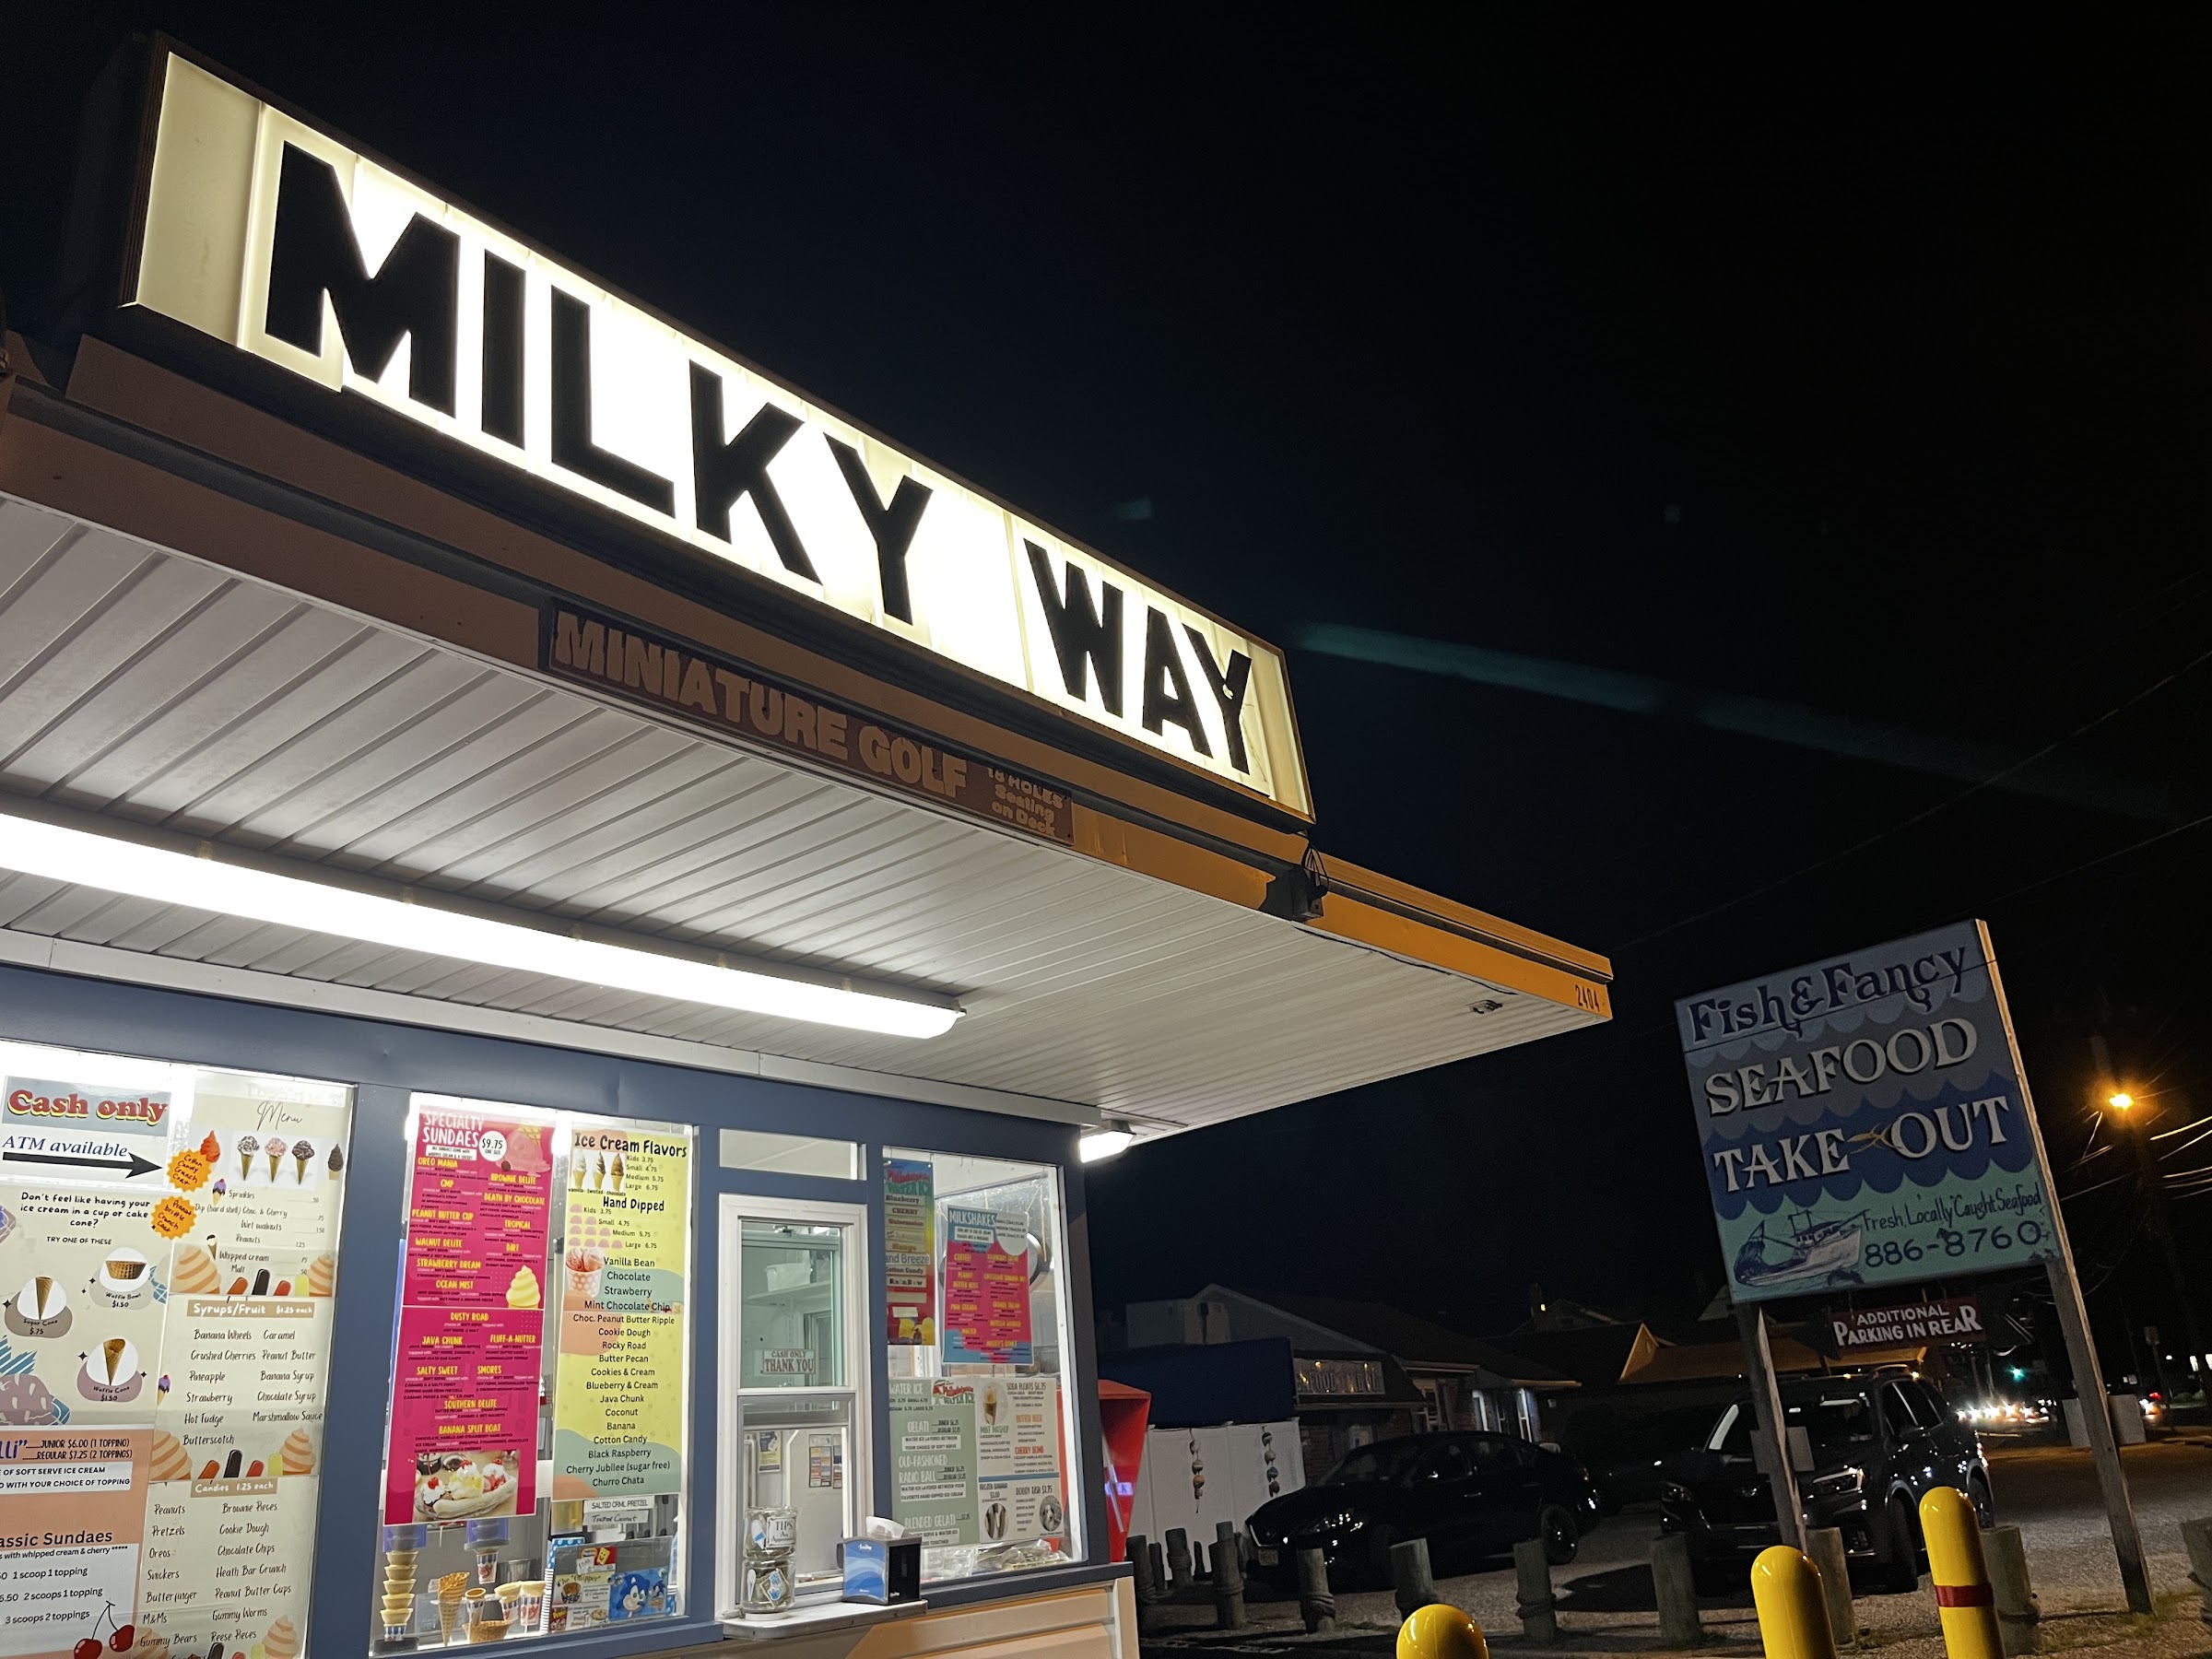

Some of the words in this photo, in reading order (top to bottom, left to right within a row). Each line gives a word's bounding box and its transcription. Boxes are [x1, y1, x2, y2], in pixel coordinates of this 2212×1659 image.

[265, 140, 934, 624] MILKY
[1022, 537, 1252, 775] WAY
[555, 610, 848, 760] MINIATURE
[859, 726, 966, 798] GOLF
[1008, 775, 1063, 808] HOLES
[995, 784, 1054, 823] Seating
[992, 802, 1013, 818] on
[1017, 808, 1054, 837] Deck
[1574, 984, 1600, 1012] 2404
[1688, 983, 1803, 1043] Fish
[1792, 976, 1825, 1014] &
[1821, 947, 1965, 1014] Fancy
[1705, 1018, 1978, 1115] SEAFOOD
[7, 1089, 88, 1118] Cash
[96, 1097, 169, 1126] only
[256, 1100, 302, 1131] Menu
[424, 1112, 484, 1131] SPECIALTY
[422, 1126, 479, 1147] SUNDAES
[2, 1135, 46, 1150] ATM
[50, 1141, 128, 1157] available
[482, 1139, 503, 1148] $9.75
[575, 1133, 595, 1147] Ice
[600, 1135, 639, 1152] Cream
[643, 1140, 687, 1158] Flavors
[1713, 1128, 1850, 1193] TAKE
[1889, 1095, 2010, 1159] OUT
[178, 1160, 198, 1173] Candy
[21, 1192, 49, 1201] Don't
[53, 1194, 72, 1202] feel
[75, 1195, 91, 1204] like
[95, 1196, 126, 1208] having
[129, 1200, 150, 1208] your
[603, 1196, 627, 1208] Hand
[630, 1199, 665, 1214] Dipped
[1995, 1182, 2041, 1216] Seafood
[70, 1218, 99, 1228] cone?
[949, 1209, 995, 1227] MILKSHAKES
[1865, 1220, 2041, 1267] 886-8760
[417, 1258, 457, 1267] STRAWBERRY
[460, 1260, 480, 1268] DREAM
[604, 1257, 631, 1266] Vanilla
[901, 1253, 929, 1264] Breeze
[606, 1272, 651, 1281] Chocolate
[605, 1287, 653, 1298] Strawberry
[451, 1312, 469, 1321] DUSTY
[472, 1312, 488, 1321] ROAD
[573, 1314, 595, 1323] Choc.
[653, 1316, 675, 1325] Ripple
[1857, 1304, 1950, 1326] ADDITIONAL
[1833, 1322, 1903, 1346] PARKING
[1907, 1323, 1925, 1338] IN
[1928, 1305, 1982, 1335] REAR
[194, 1329, 226, 1340] Banana
[228, 1330, 252, 1340] Wheels
[263, 1330, 296, 1340] Caramel
[627, 1329, 651, 1338] Dough
[422, 1336, 440, 1345] JAVA
[442, 1336, 463, 1345] CHUNK
[603, 1342, 625, 1350] Rocky
[191, 1350, 222, 1360] Crushed
[225, 1351, 256, 1360] Cherries
[262, 1349, 288, 1360] Peanut
[291, 1350, 316, 1360] Butter
[417, 1366, 436, 1375] SALTY
[439, 1366, 457, 1374] SWEET
[765, 1359, 794, 1371] THANK
[796, 1359, 814, 1371] YOU
[189, 1371, 226, 1383] Pineapple
[260, 1371, 290, 1381] Banana
[293, 1371, 314, 1382] Syrup
[186, 1393, 232, 1405] Strawberry
[257, 1391, 291, 1401] Chocolate
[295, 1392, 317, 1404] Syrup
[444, 1400, 476, 1408] SOUTHERN
[478, 1399, 497, 1407] DELITE
[184, 1413, 197, 1423] Hot
[201, 1413, 224, 1427] Fudge
[253, 1411, 300, 1422] Marshmallow
[302, 1411, 324, 1421] Sauce
[439, 1426, 465, 1434] BANANA
[467, 1425, 482, 1433] SPLIT
[485, 1424, 501, 1432] BOAT
[908, 1421, 929, 1432] GELATI
[182, 1434, 234, 1445] Butterscotch
[594, 1436, 621, 1444] Cotton
[623, 1435, 647, 1444] Candy
[612, 1449, 652, 1458] Raspberry
[899, 1454, 947, 1467] OLD-FASHIONED
[567, 1466, 594, 1475] Cherry
[596, 1464, 625, 1472] Jubilee
[627, 1463, 650, 1472] (sugar
[653, 1461, 671, 1469] free)
[593, 1478, 619, 1487] Churro
[621, 1477, 644, 1485] Chata
[899, 1472, 919, 1484] RADIO
[194, 1484, 229, 1493] Candies
[154, 1504, 186, 1515] Peanuts
[221, 1503, 253, 1513] Brownie
[256, 1500, 278, 1511] Pieces
[904, 1514, 932, 1529] BLENDED
[935, 1513, 957, 1526] GELATI
[151, 1525, 185, 1536] Pretzels
[219, 1524, 242, 1535] Cookie
[246, 1523, 269, 1535] Dough
[147, 1570, 179, 1581] Snickers
[216, 1567, 239, 1578] Heath
[241, 1565, 257, 1575] Bar
[259, 1563, 287, 1574] Crunch
[215, 1587, 241, 1599] Peanut
[244, 1586, 271, 1597] Butter
[273, 1583, 291, 1596] Cups
[145, 1591, 198, 1604] Butterfinger
